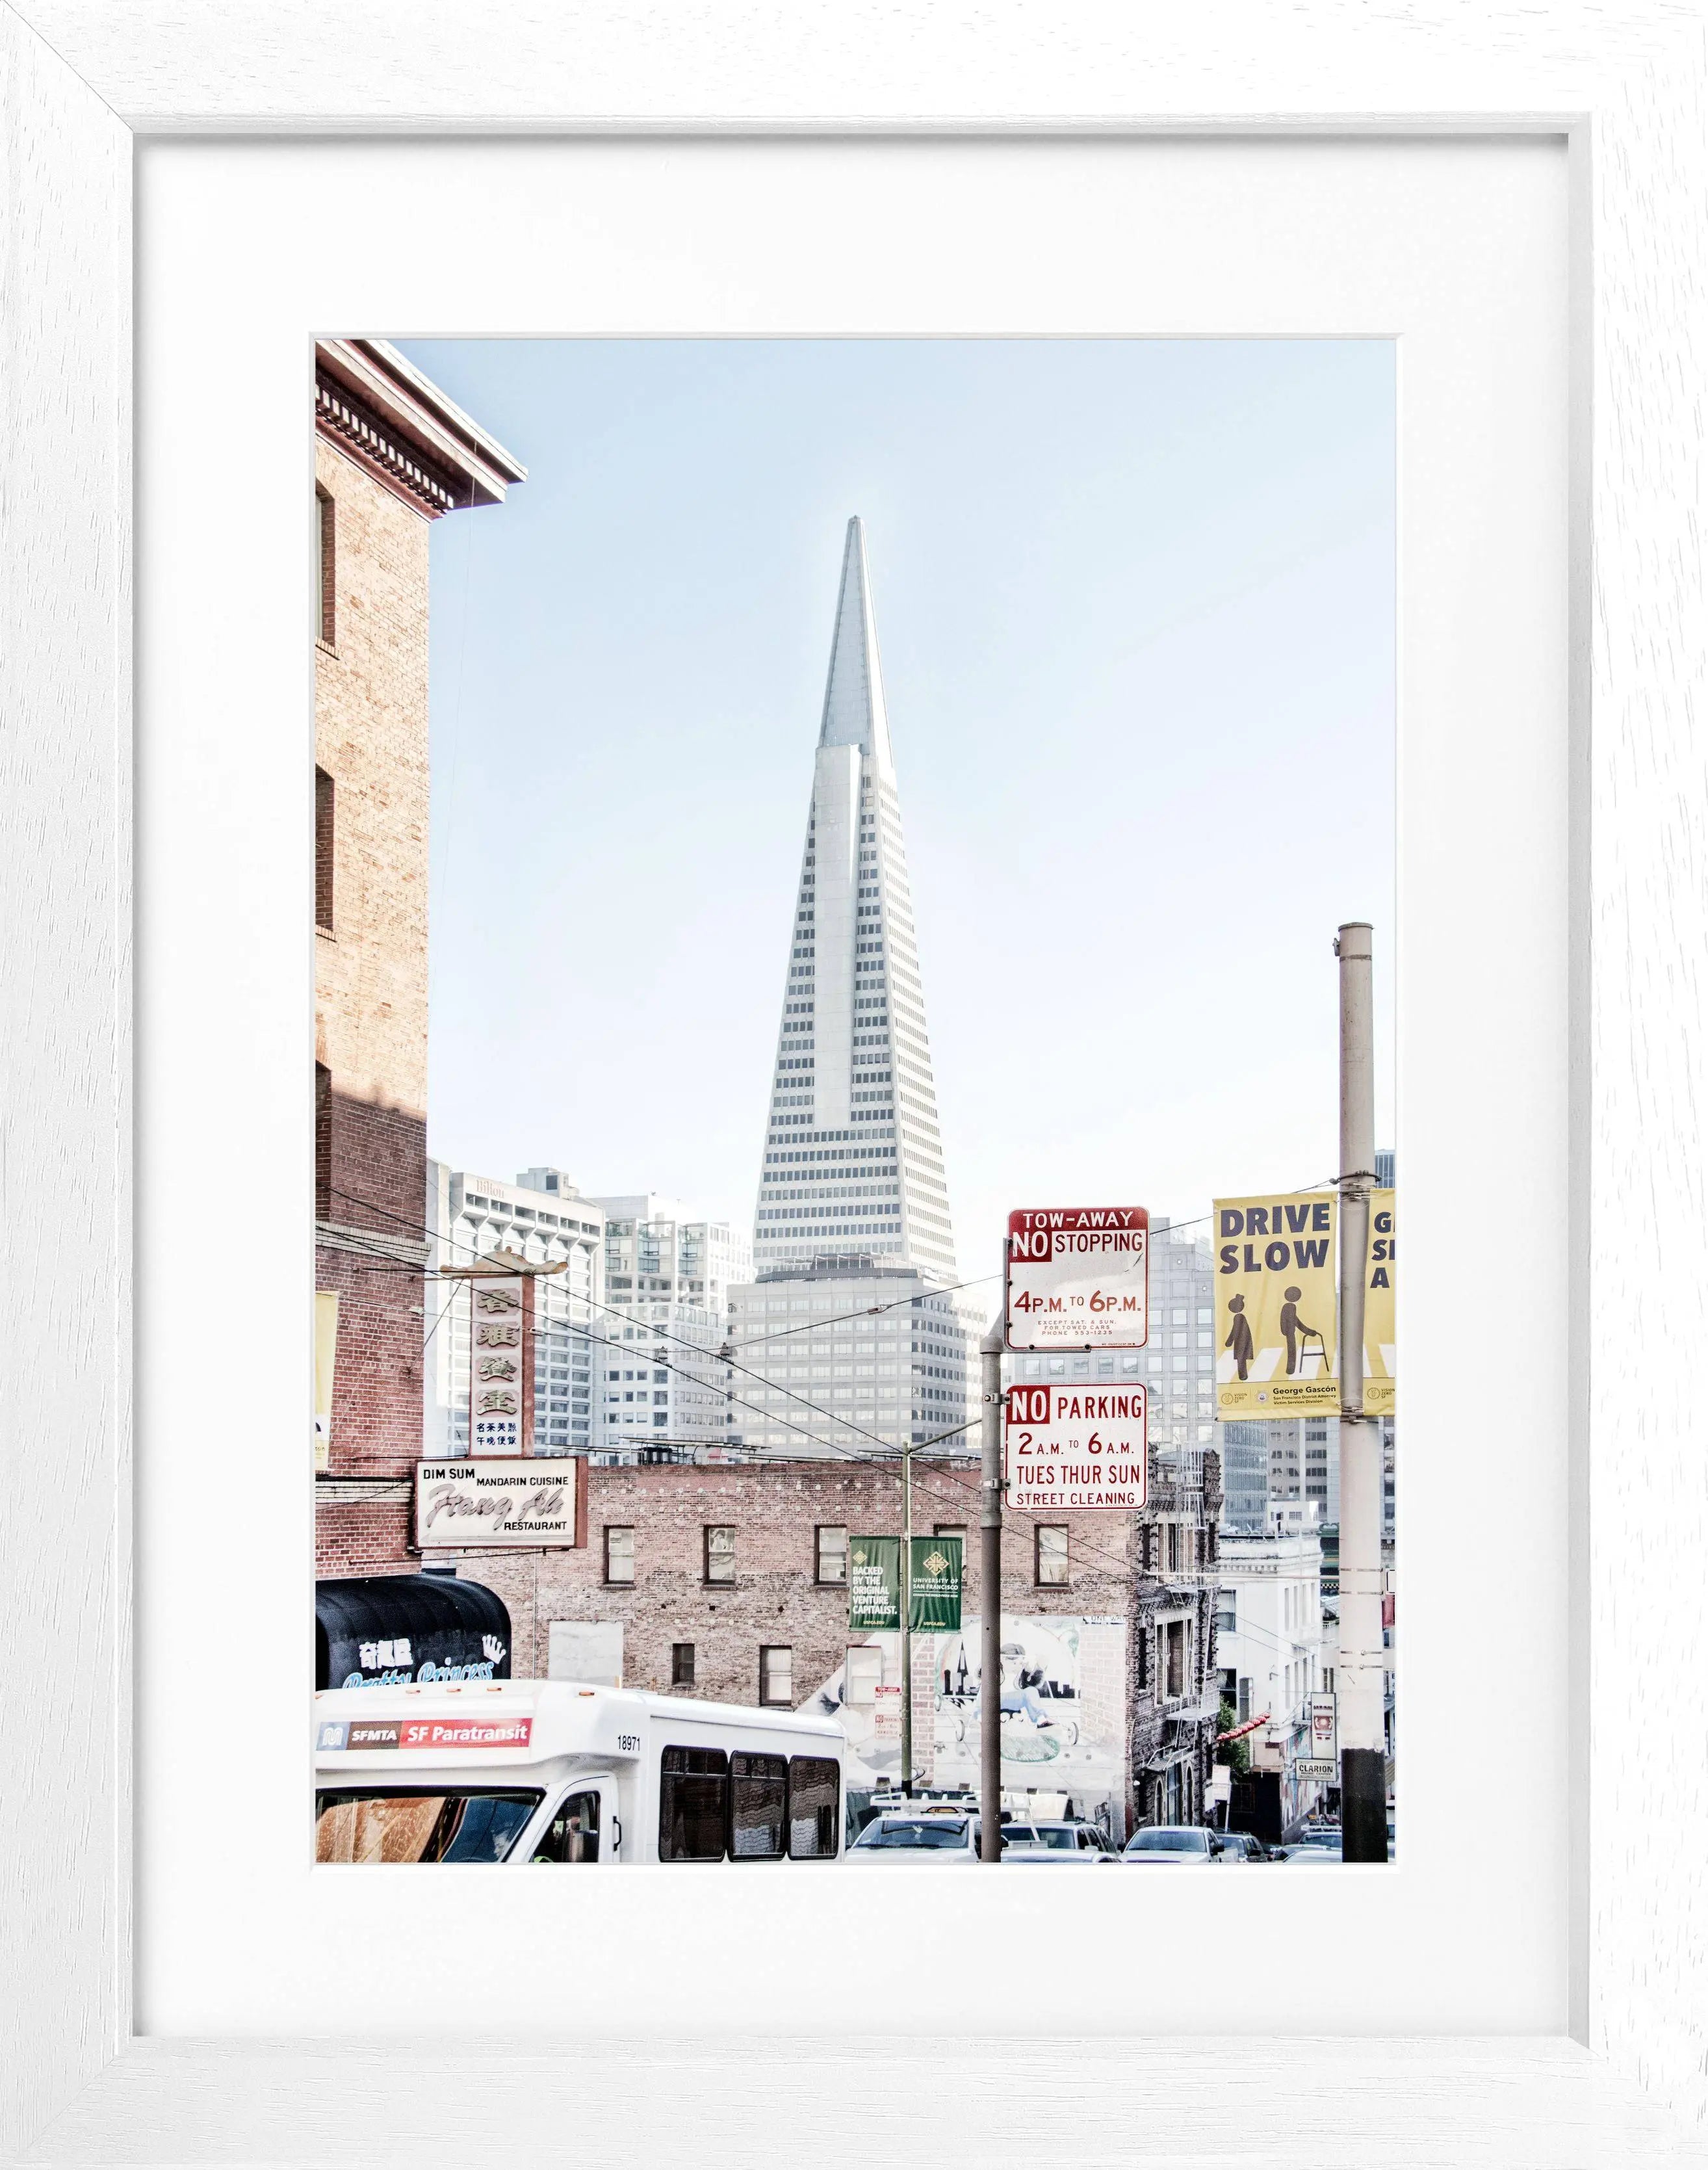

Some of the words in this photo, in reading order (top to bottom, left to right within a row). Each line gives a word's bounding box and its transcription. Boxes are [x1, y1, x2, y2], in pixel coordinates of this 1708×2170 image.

[476, 1179, 504, 1199] Hilton
[1023, 1211, 1133, 1229] TOW-AWAY
[1220, 1203, 1330, 1238] DRIVE
[1374, 1212, 1395, 1233] G
[1013, 1231, 1048, 1257] NO
[1055, 1233, 1144, 1253] STOPPING
[1219, 1239, 1330, 1274] SLOW
[1370, 1268, 1390, 1288] A
[1070, 1296, 1084, 1306] TO
[1012, 1390, 1047, 1422] NO
[1058, 1395, 1141, 1419] PARKING
[1068, 1440, 1079, 1448] TO
[423, 1469, 445, 1479] DIM
[449, 1468, 475, 1479] SUM
[476, 1477, 526, 1486] MANDARIN
[530, 1476, 569, 1485] CUISINE
[1016, 1465, 1055, 1485] TUES
[1061, 1465, 1102, 1484] THUR
[1108, 1465, 1140, 1484] SUN
[426, 1483, 513, 1530] Hang
[518, 1487, 564, 1521] Ah
[1016, 1493, 1065, 1505] STREET
[1070, 1492, 1135, 1504] CLEANING
[504, 1521, 567, 1530] RESTAURANT
[853, 1566, 883, 1575] BACKED
[853, 1576, 863, 1585] BY
[865, 1576, 881, 1585] THE
[853, 1586, 889, 1595] ORIGINAL
[853, 1595, 889, 1604] VENTURE
[853, 1605, 898, 1614] CAPITALIST.
[417, 1656, 495, 1682] Princess
[352, 1729, 398, 1742] SFMTA
[408, 1726, 429, 1742] SF
[433, 1724, 528, 1742] Paratransit
[617, 1734, 640, 1751] 18971
[1299, 1764, 1333, 1773] CLARION
